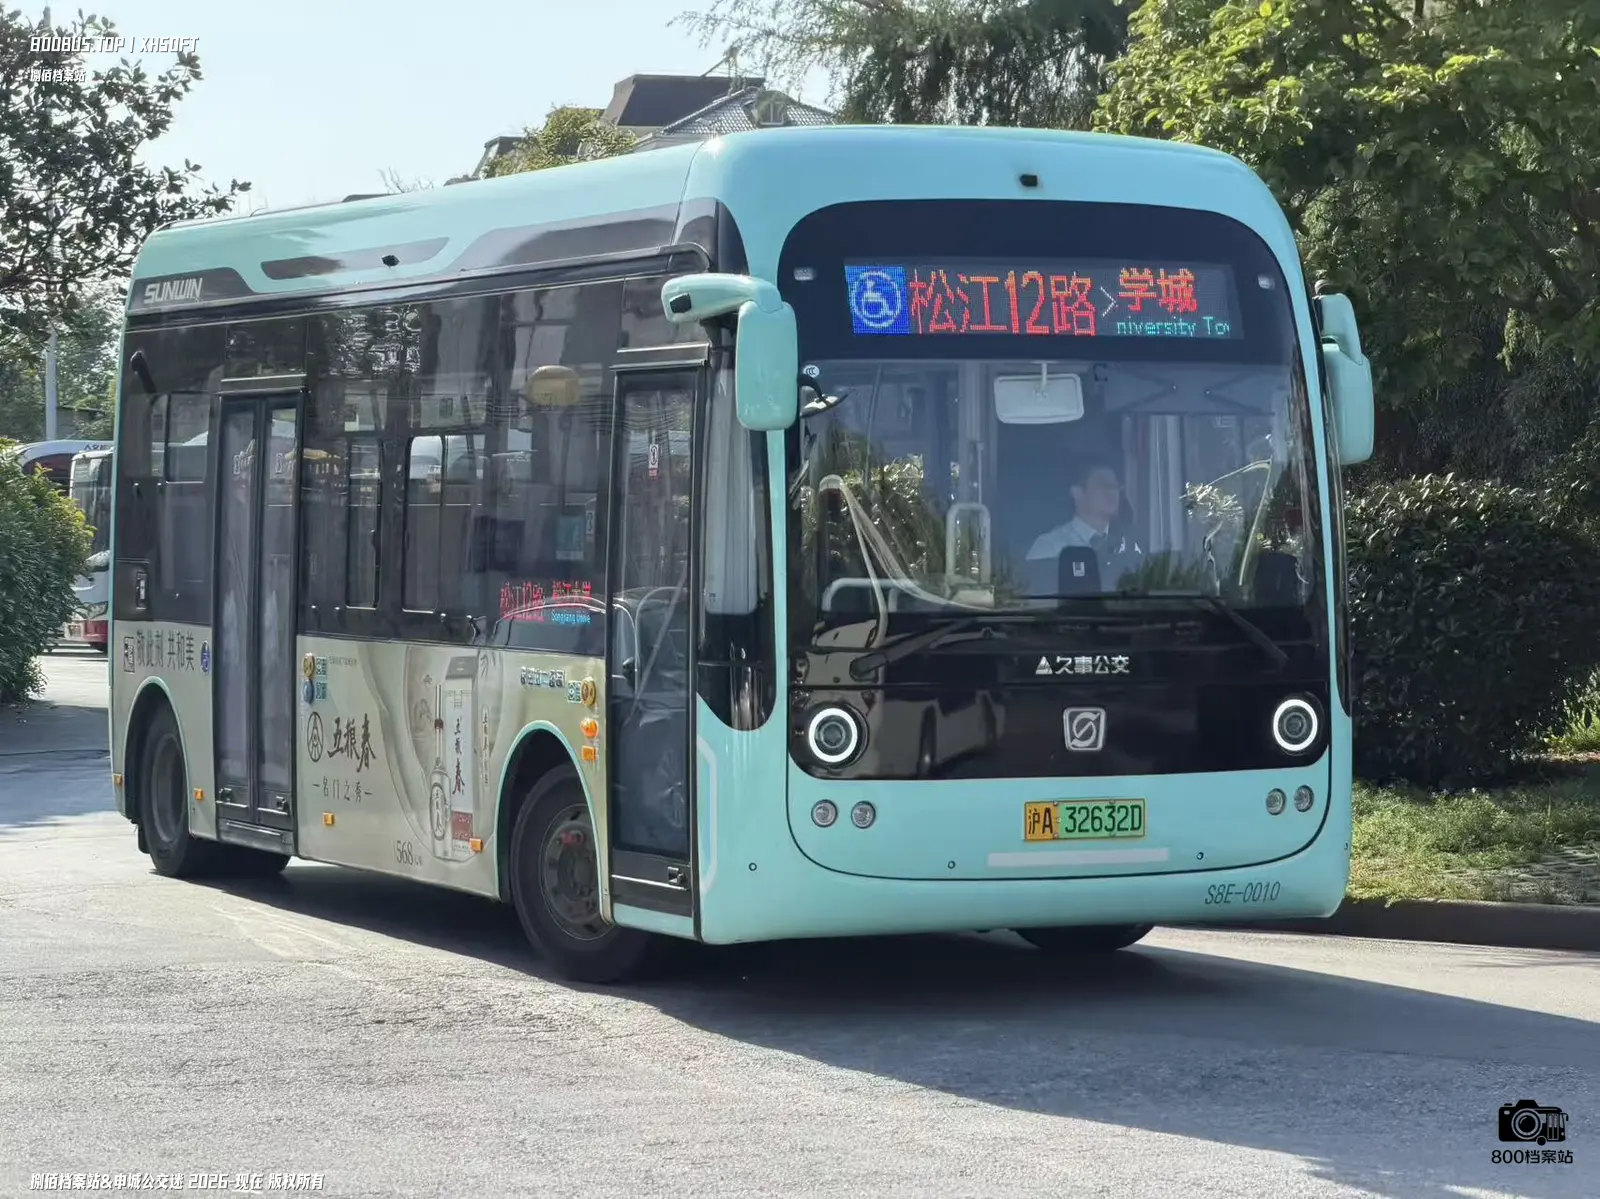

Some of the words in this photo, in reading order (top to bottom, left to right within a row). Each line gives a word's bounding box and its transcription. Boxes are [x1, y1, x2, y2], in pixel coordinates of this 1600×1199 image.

[143, 278, 203, 304] SUNWIN
[909, 268, 1096, 336] 松江12路
[1118, 267, 1198, 313] 学城
[1204, 881, 1281, 905] S8E-0010
